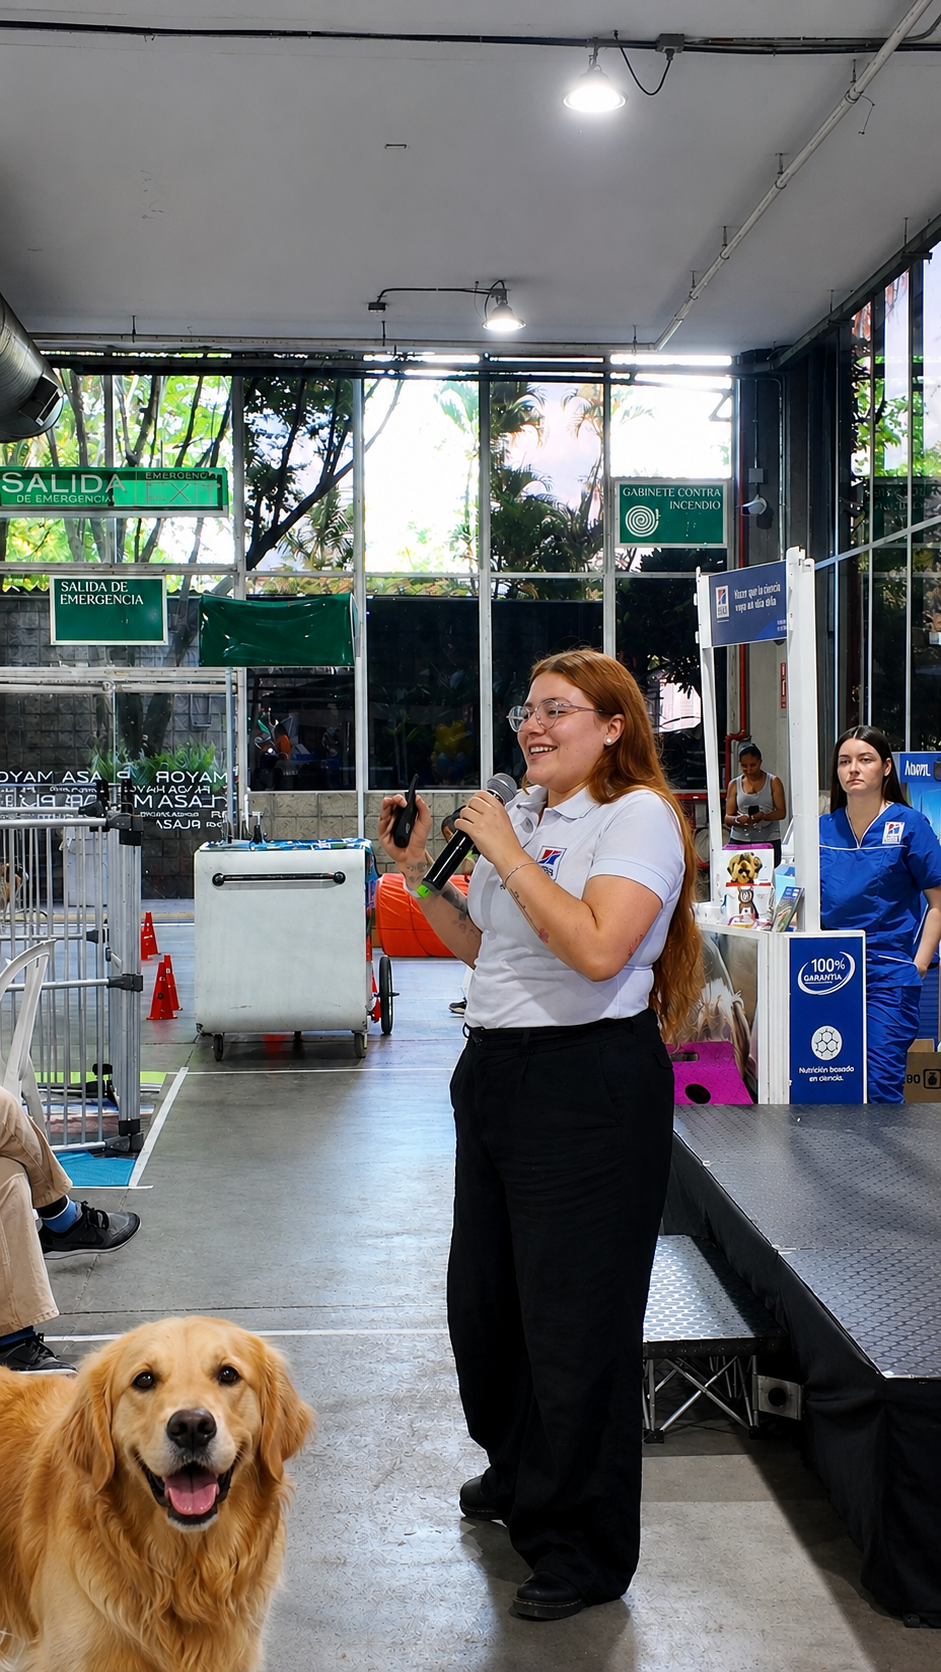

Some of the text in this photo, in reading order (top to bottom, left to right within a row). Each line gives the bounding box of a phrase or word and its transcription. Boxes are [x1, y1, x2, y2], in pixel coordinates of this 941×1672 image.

[2, 472, 127, 493] SALIDA
[622, 487, 721, 497] GABINETE CONTRA
[16, 495, 113, 503] DE EMERGENCIA
[669, 501, 721, 510] INCENDIO
[61, 582, 128, 592] SALIDA DE
[60, 594, 144, 605] EMERGENCIA
[811, 957, 845, 973] 100%
